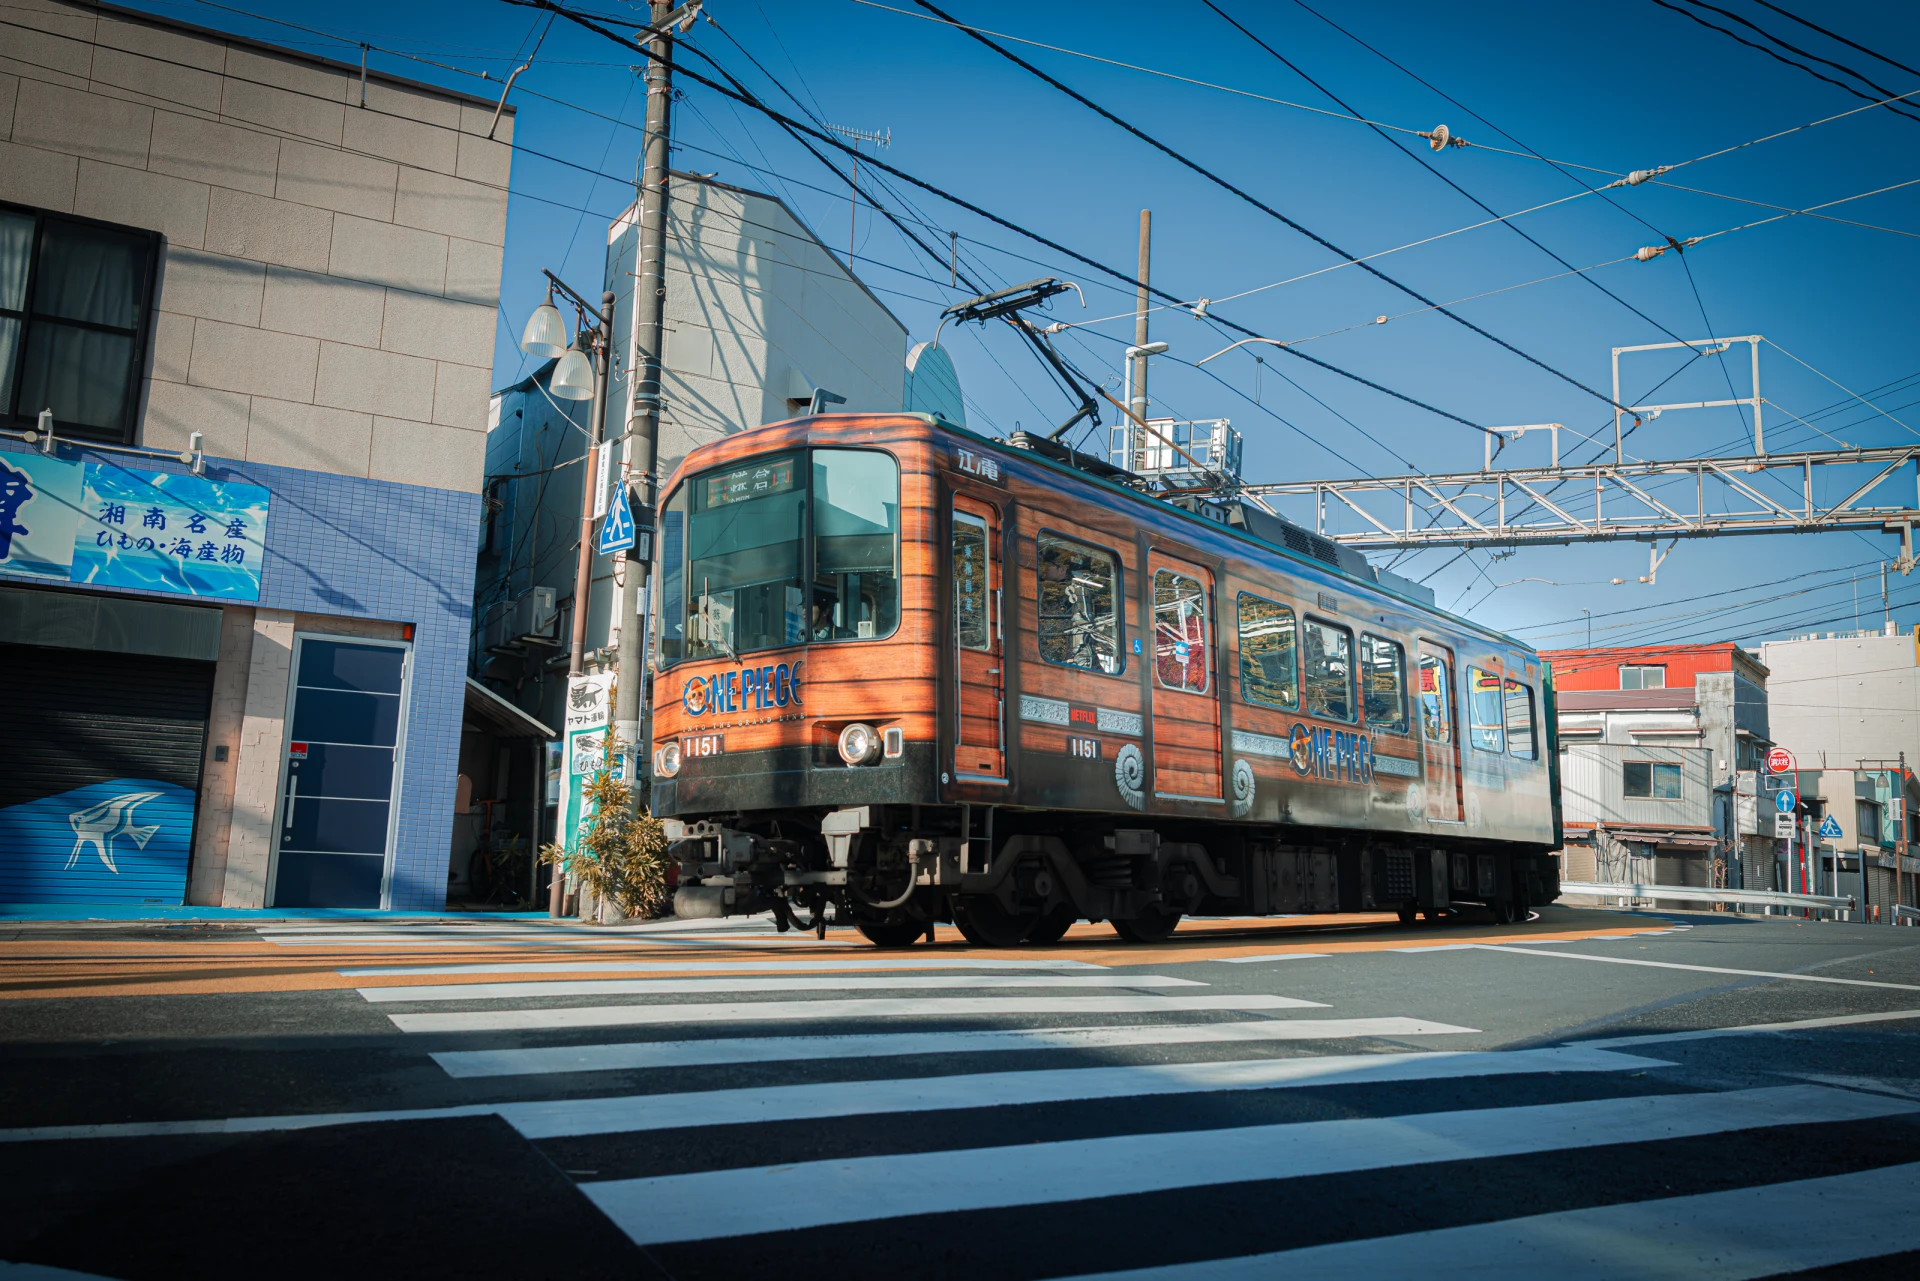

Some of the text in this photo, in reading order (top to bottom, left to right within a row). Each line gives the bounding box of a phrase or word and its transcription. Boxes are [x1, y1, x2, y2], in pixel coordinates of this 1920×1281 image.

[99, 501, 248, 540] 湘南名産
[96, 530, 245, 565] ひもの・海産物
[682, 660, 804, 718] ONE PIECE
[567, 711, 605, 726] ヤマト運輸
[682, 712, 806, 733] INTO THE GRAND LINE
[1070, 708, 1097, 725] NETFLIX
[686, 736, 717, 758] 1151
[1072, 738, 1097, 759] 1151
[1287, 722, 1380, 787] ONE PIECE
